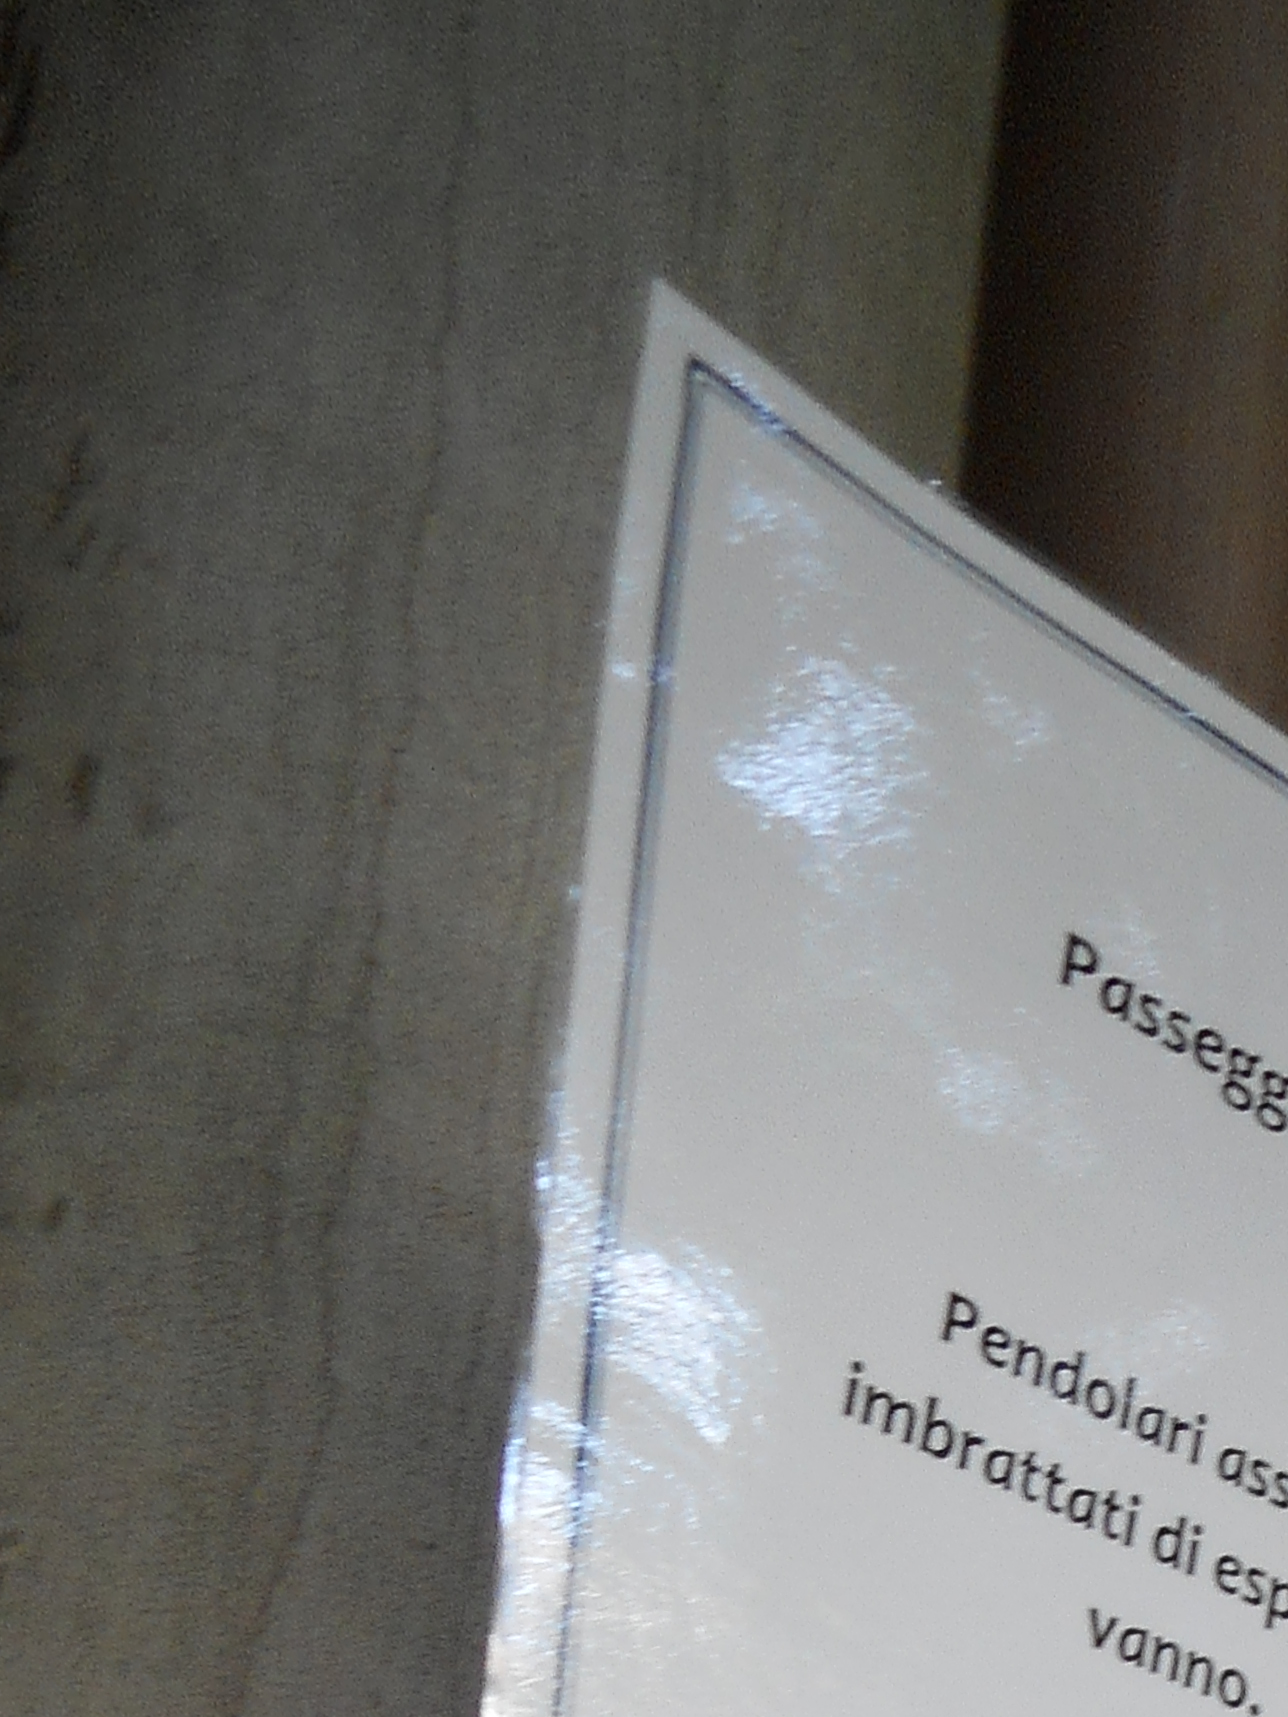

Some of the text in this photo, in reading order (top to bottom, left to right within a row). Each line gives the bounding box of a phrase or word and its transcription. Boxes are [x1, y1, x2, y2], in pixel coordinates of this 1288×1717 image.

[940, 1290, 1208, 1466] Pendolari
[842, 1360, 1142, 1548] imbrattati
[1151, 1515, 1204, 1577] di
[1088, 1607, 1261, 1717] vanno.
